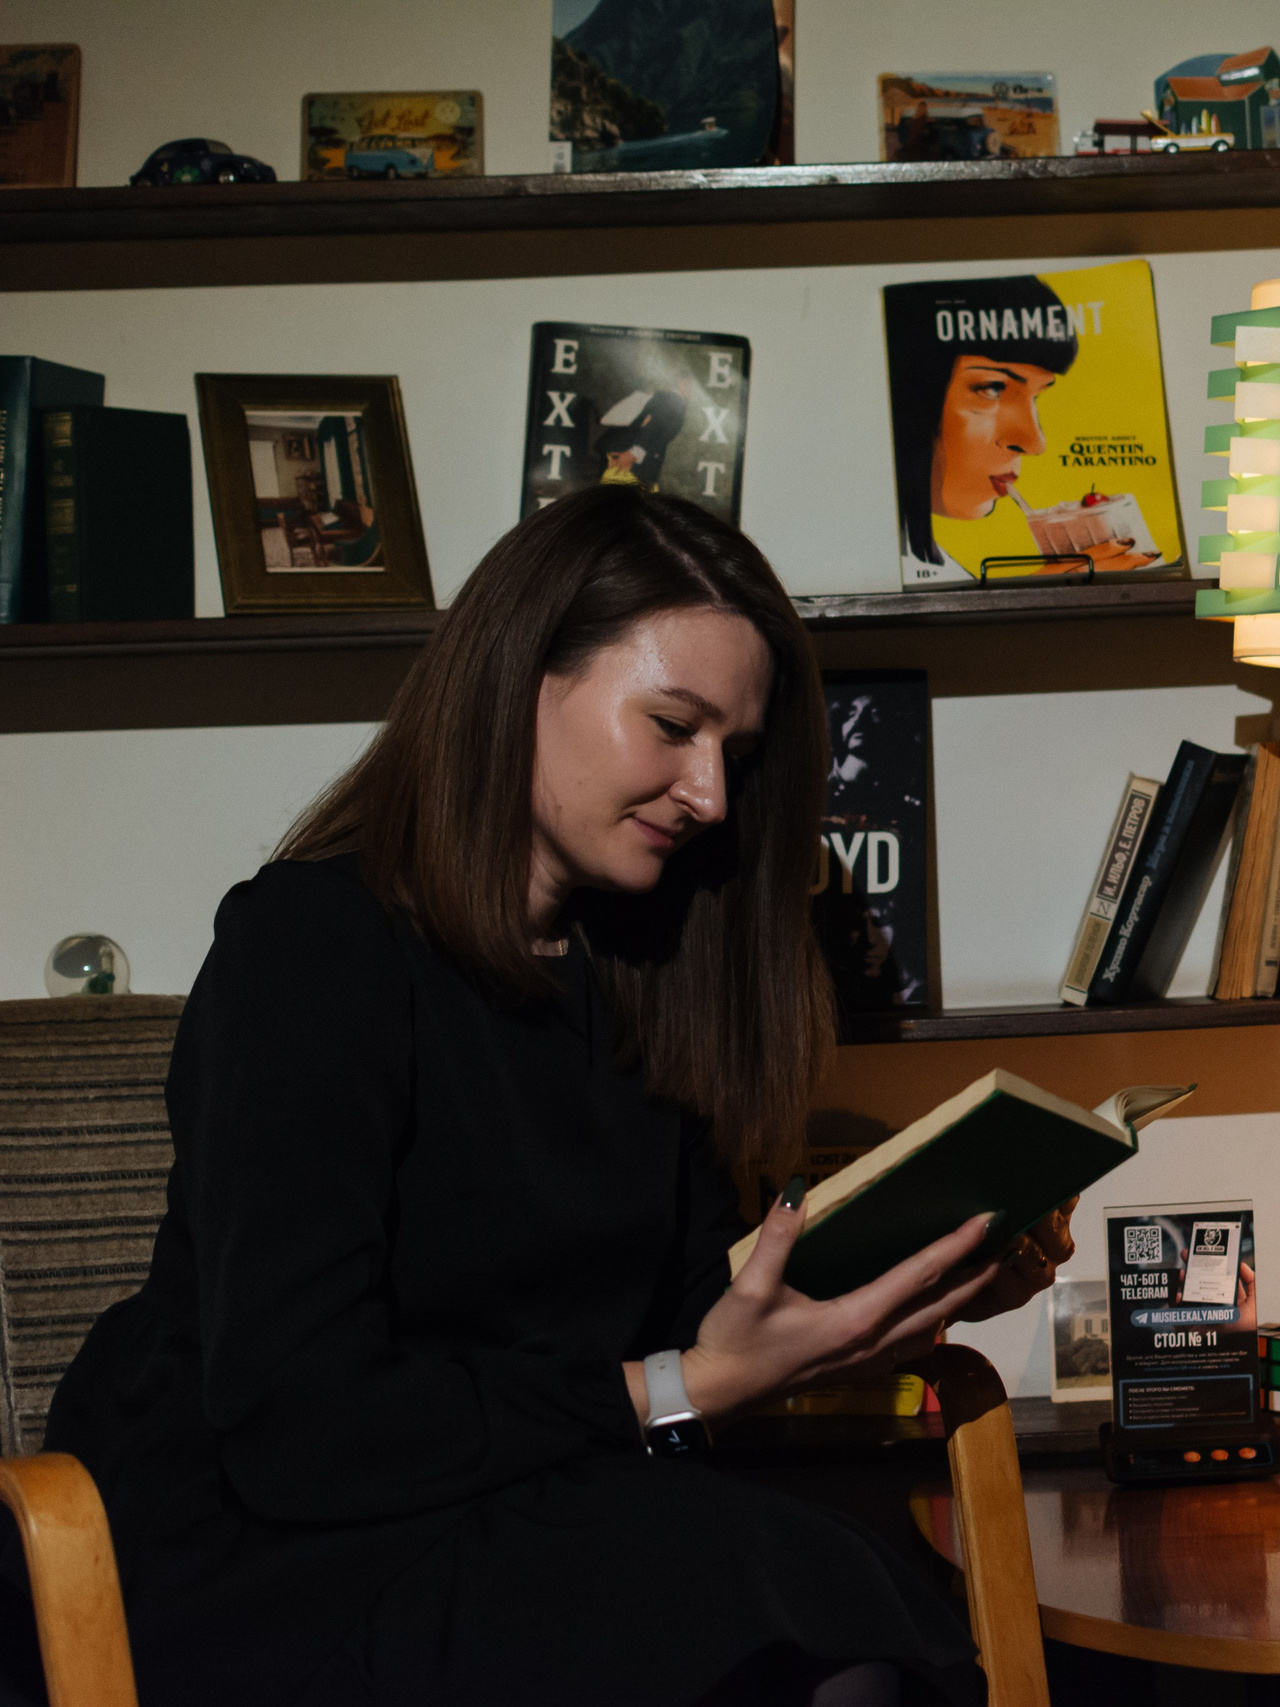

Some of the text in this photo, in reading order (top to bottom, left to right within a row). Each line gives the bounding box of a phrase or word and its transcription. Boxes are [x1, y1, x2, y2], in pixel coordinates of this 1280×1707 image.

[934, 300, 1106, 342] ORNAMENT
[1069, 442, 1144, 456] QUENTIN
[1058, 454, 1157, 467] TARANTINO
[915, 568, 939, 580] 18+
[1106, 850, 1131, 884] ИЛЬФ,
[1121, 797, 1147, 840] ПЕТРОВ
[1101, 875, 1153, 983] Хулио Кортасар
[1120, 1272, 1169, 1287] ЧАТ-БОТ В
[1120, 1286, 1169, 1300] TELEGRAM
[1151, 1308, 1235, 1323] MUSIELEKALYANBOT
[1153, 1330, 1218, 1349] СТОЛ № 11
